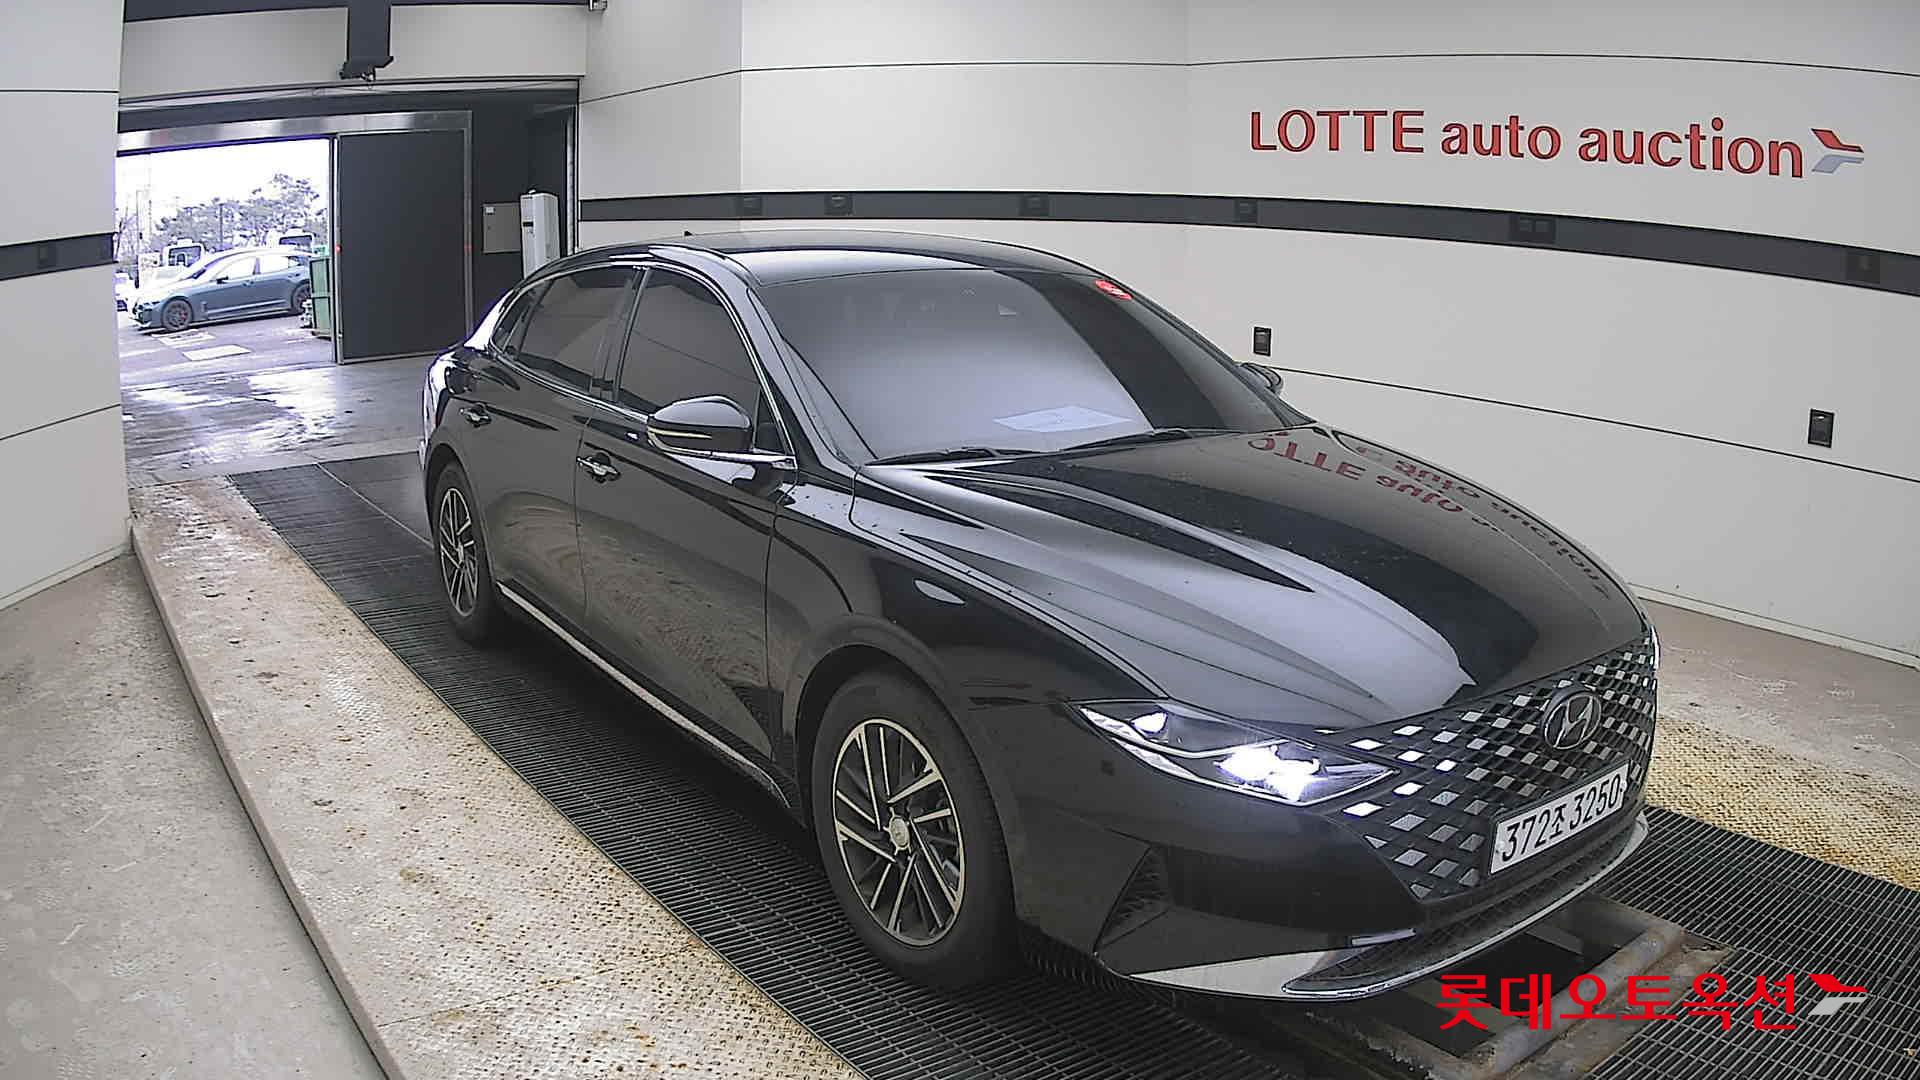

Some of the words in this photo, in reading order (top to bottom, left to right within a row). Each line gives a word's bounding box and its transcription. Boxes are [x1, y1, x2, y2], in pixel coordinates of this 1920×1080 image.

[1251, 110, 1424, 153] LOTTE
[1441, 114, 1562, 159] auto
[1578, 117, 1803, 178] auction
[1569, 773, 1621, 830] 3250
